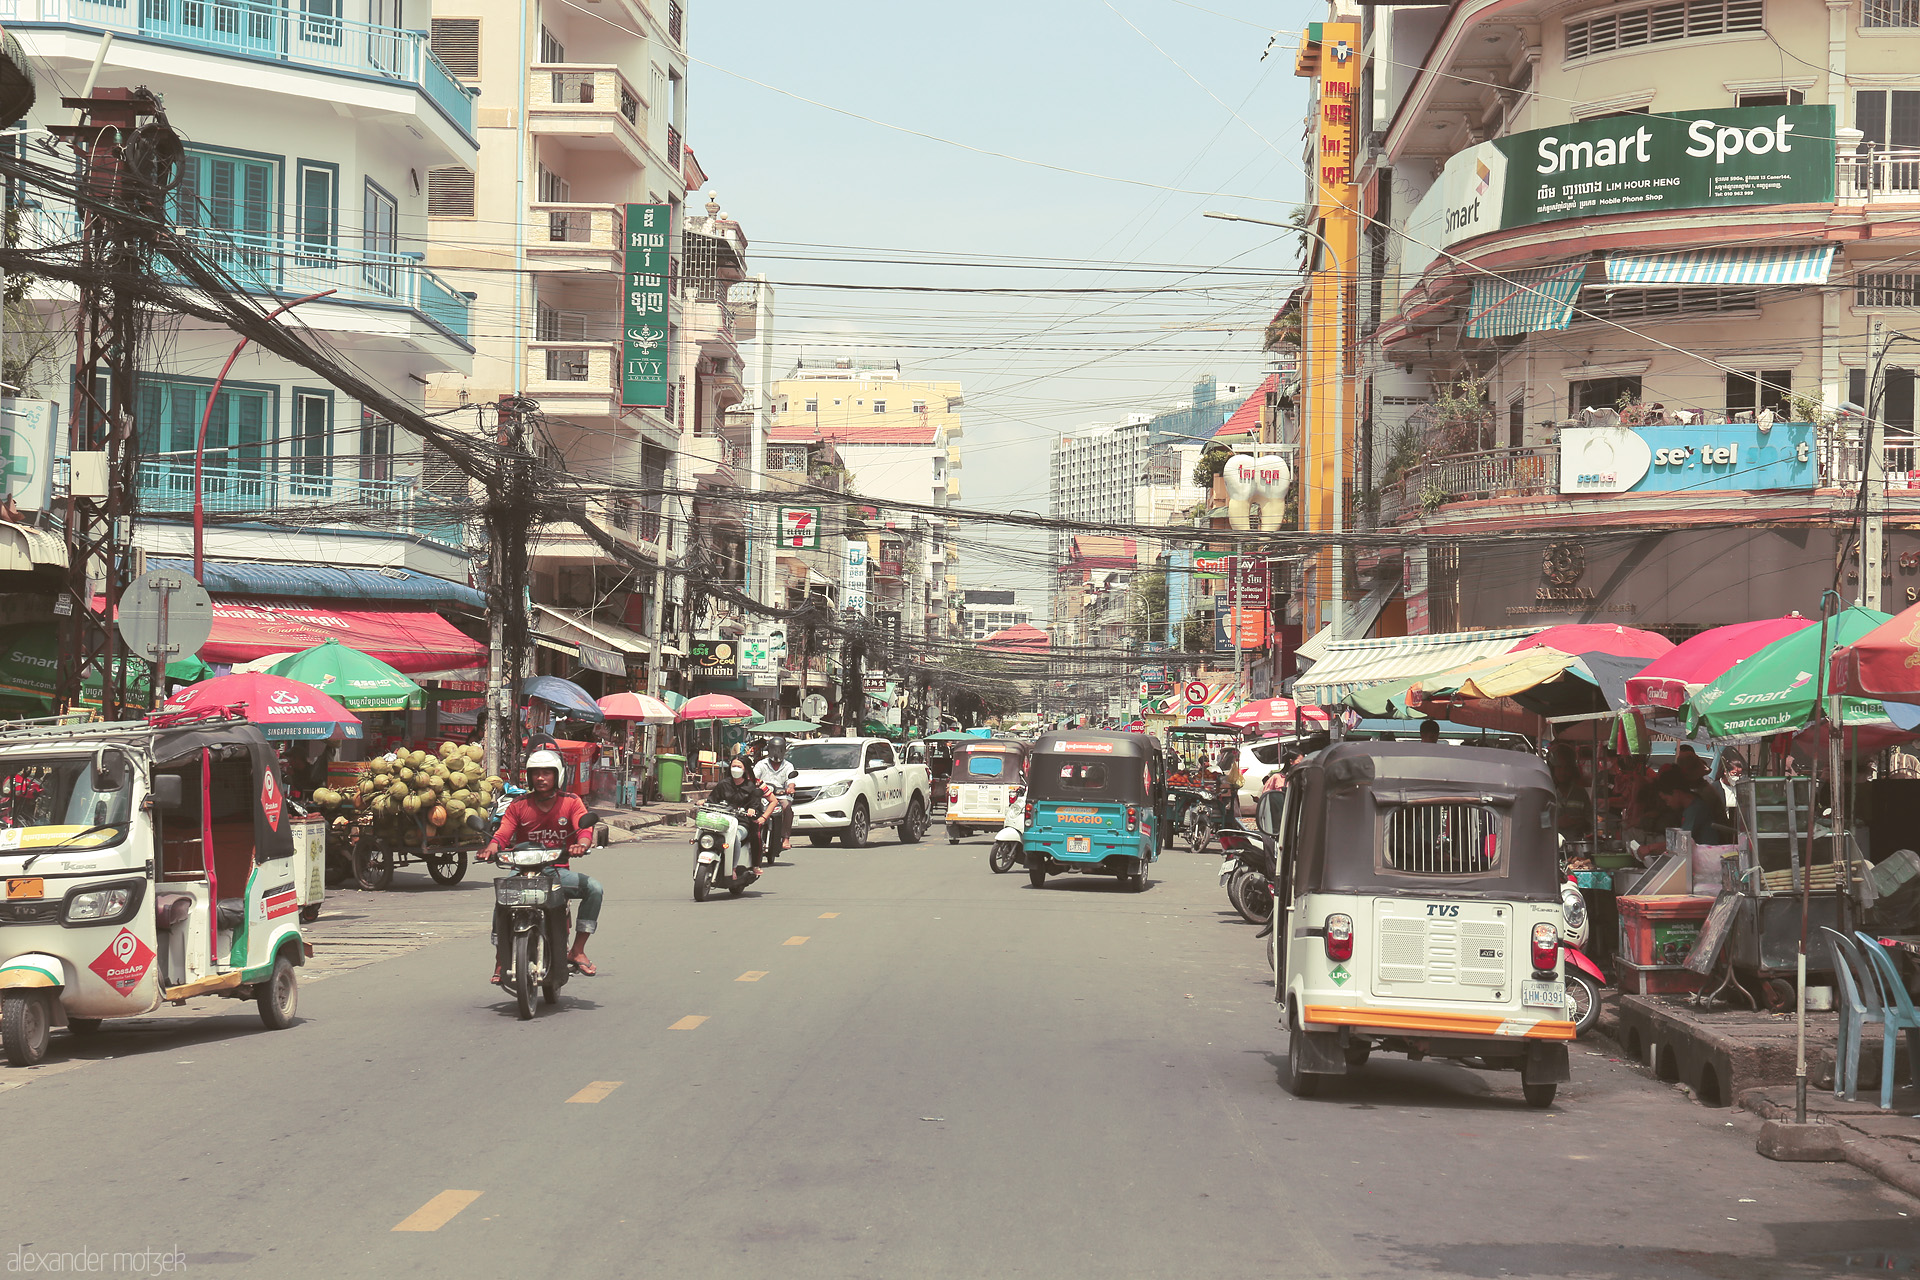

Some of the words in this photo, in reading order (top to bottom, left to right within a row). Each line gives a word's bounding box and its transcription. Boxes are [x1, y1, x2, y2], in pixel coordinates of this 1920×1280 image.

[1536, 124, 1653, 174] Smart
[1685, 114, 1795, 164] Spot
[1606, 182, 1622, 192] LIM
[1624, 179, 1651, 190] HOUR
[1653, 177, 1681, 188] HENG
[1599, 197, 1621, 206] Mobile
[1622, 195, 1643, 204] Phone
[1645, 193, 1663, 203] Shop
[1445, 196, 1480, 234] Smart
[628, 361, 663, 375] IVY
[1577, 471, 1618, 485] seatel
[1196, 556, 1228, 572] Smil
[1535, 587, 1595, 600] SABRINA
[10, 650, 59, 670] Smart
[700, 654, 736, 667] Seoul
[12, 676, 57, 690] smart.com.k
[1729, 687, 1793, 706] Smart
[267, 705, 316, 715] ANCHOR
[1723, 711, 1791, 730] smart.com.kh
[267, 727, 302, 736] SINGAPORE'S
[302, 727, 327, 736] ORIGINAL
[877, 790, 888, 802] SUN
[889, 789, 903, 800] MOON
[1057, 814, 1103, 825] PIAGGIO
[528, 829, 568, 841] ETIHAD
[14, 905, 37, 915] TVS
[1426, 904, 1460, 917] TVS
[1332, 972, 1348, 980] LPG
[1523, 990, 1563, 1003] 1HM-0391
